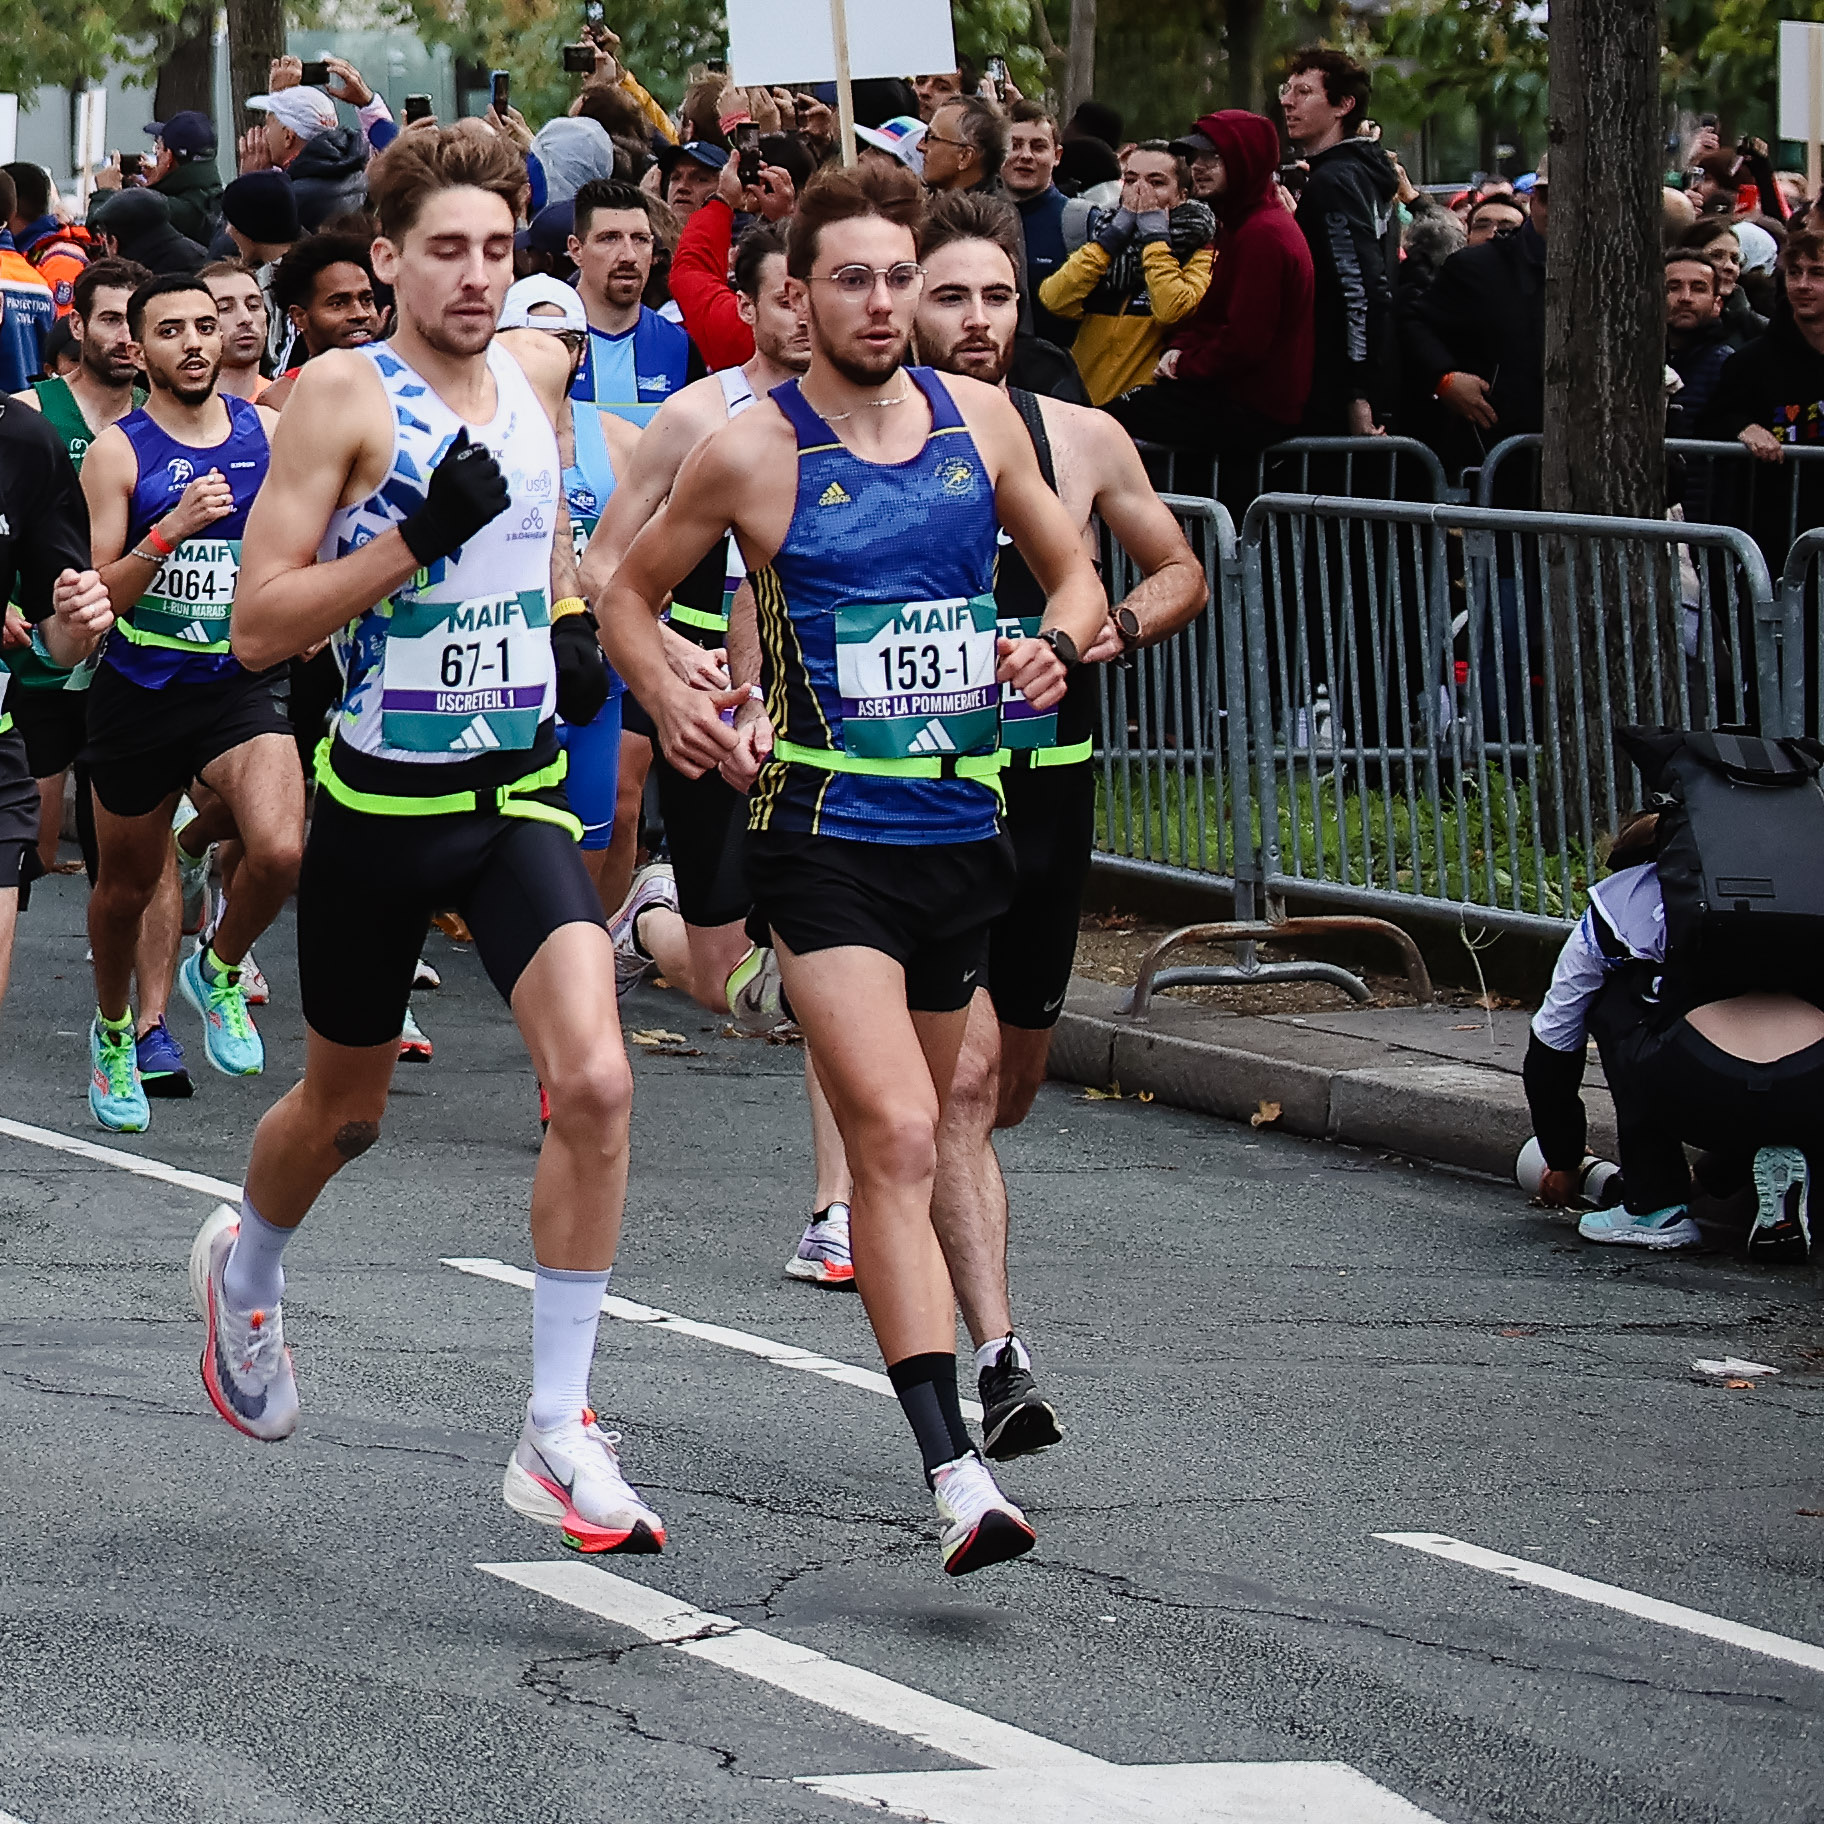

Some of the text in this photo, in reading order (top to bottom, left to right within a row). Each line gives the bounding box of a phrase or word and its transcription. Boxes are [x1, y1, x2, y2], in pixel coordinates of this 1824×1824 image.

[818, 494, 851, 507] adidas
[174, 544, 230, 562] MAIF
[192, 604, 227, 618] MARAIS
[447, 600, 521, 634] MAIF
[894, 605, 970, 635] MAIF
[441, 637, 510, 688] 67-1
[879, 641, 969, 691] 153-1
[436, 690, 515, 712] USCRETEIL 1
[858, 699, 890, 717] ASEC
[894, 697, 909, 714] LA
[982, 689, 987, 706] 1
